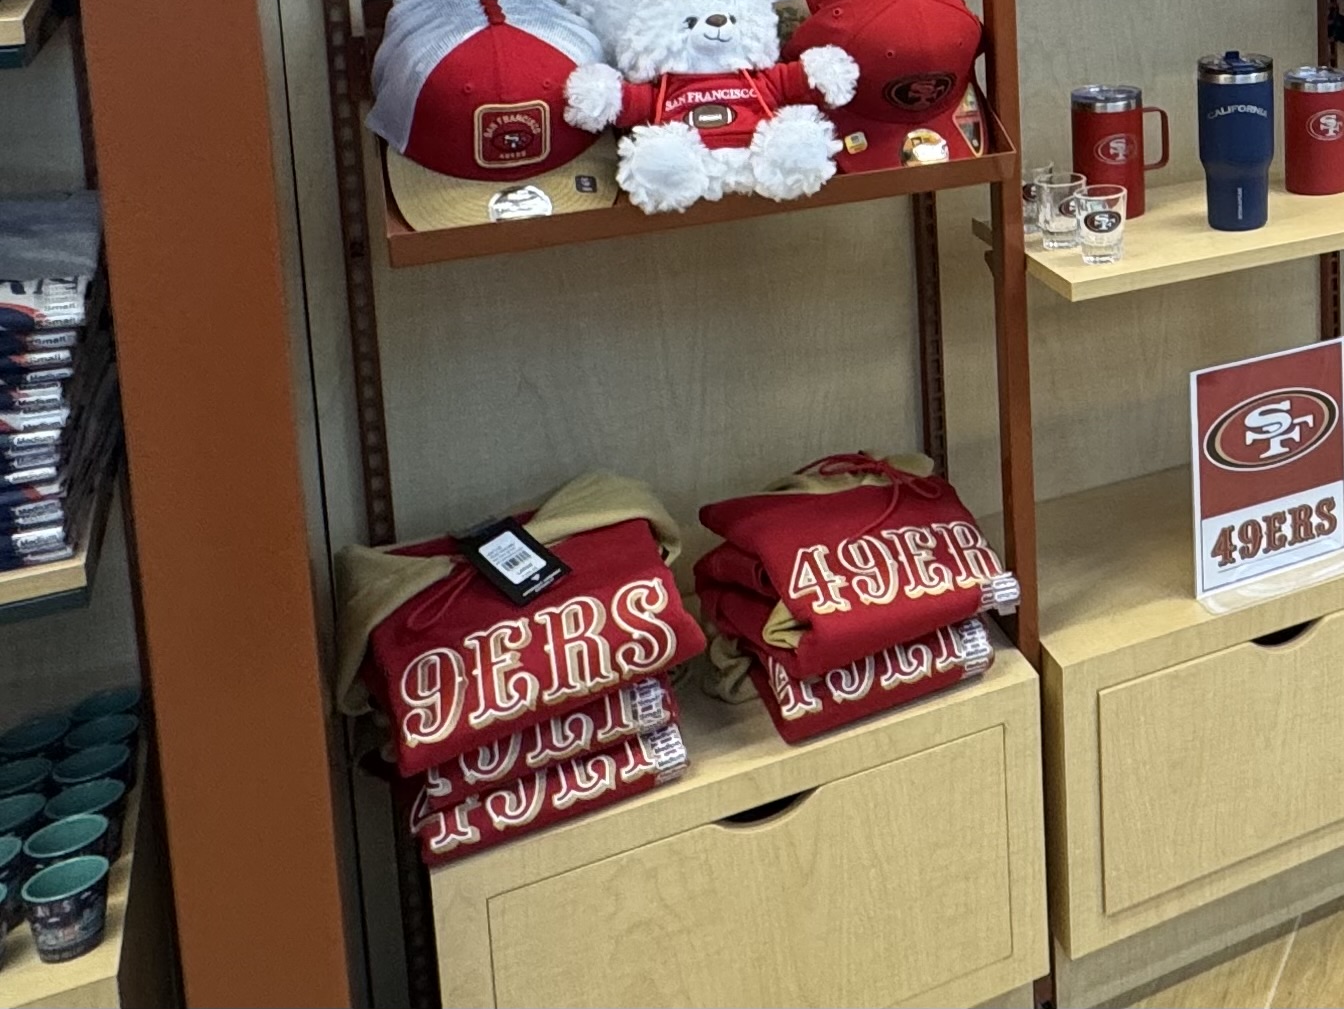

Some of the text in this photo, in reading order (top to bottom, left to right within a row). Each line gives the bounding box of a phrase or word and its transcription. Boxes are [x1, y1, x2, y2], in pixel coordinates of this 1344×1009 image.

[664, 94, 686, 112] SAN
[1207, 104, 1268, 120] CALIFORNIA
[1244, 399, 1314, 459] SF
[1210, 495, 1338, 568] 49ERS
[788, 520, 1007, 615] 49ER
[400, 576, 678, 748] 9ERS
